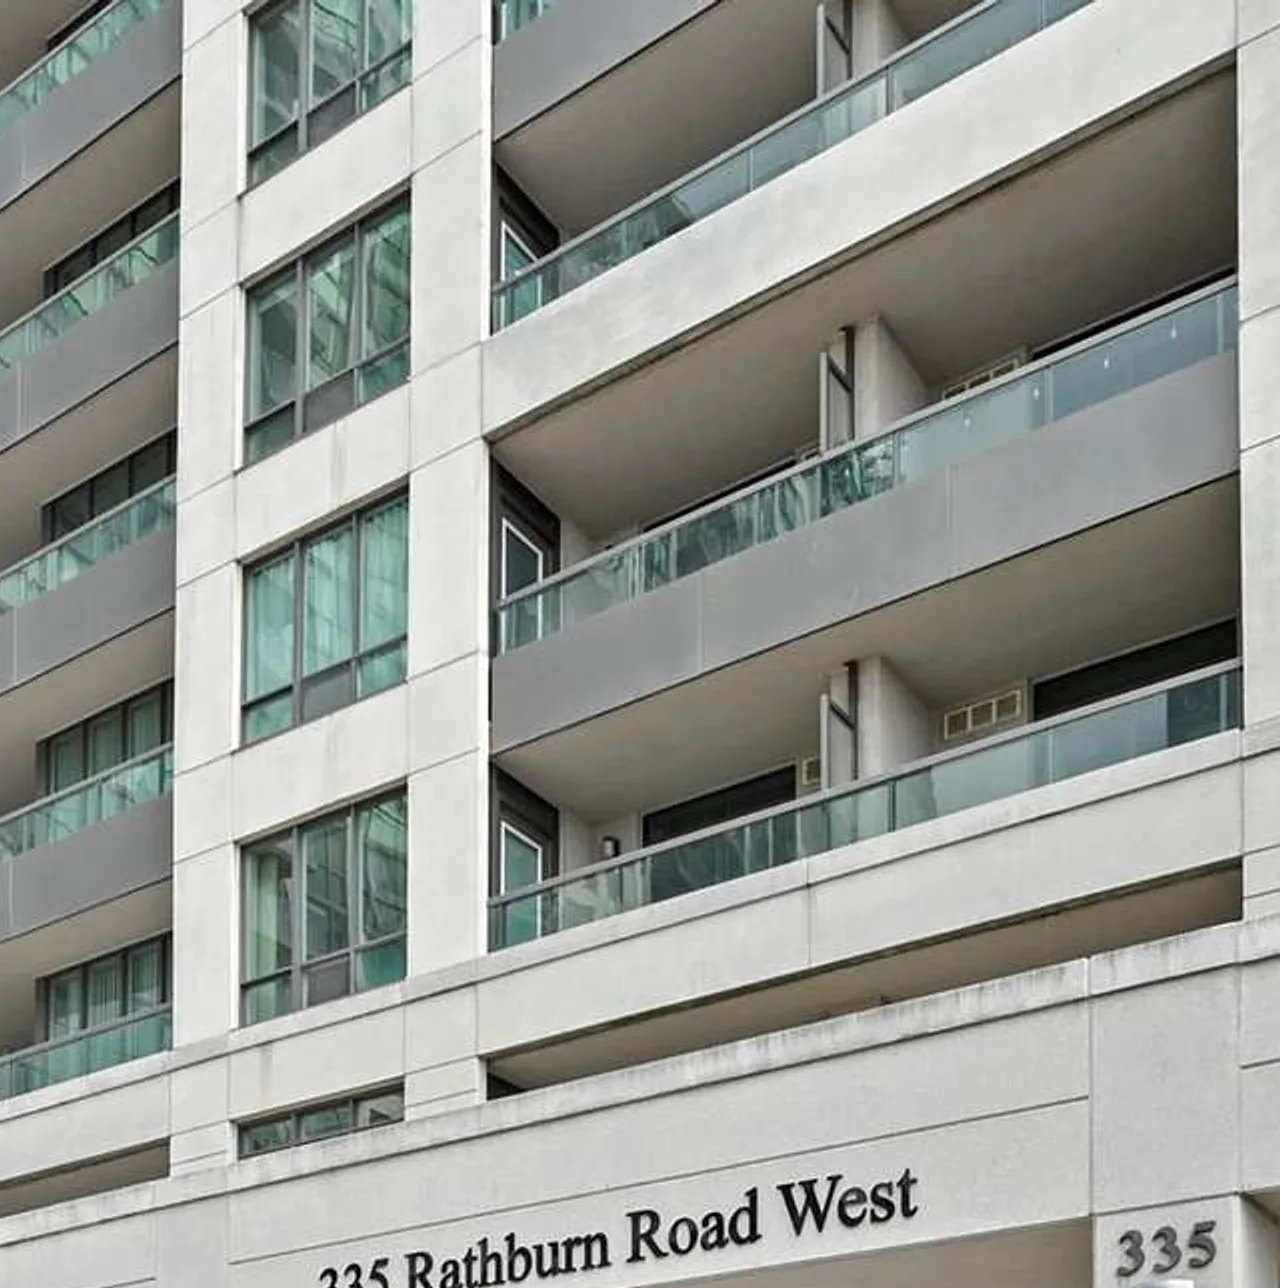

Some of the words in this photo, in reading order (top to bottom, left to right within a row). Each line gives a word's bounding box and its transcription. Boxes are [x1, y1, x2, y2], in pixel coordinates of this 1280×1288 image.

[625, 1186, 763, 1264] Road
[776, 1168, 920, 1237] West
[1115, 1220, 1218, 1279] 335
